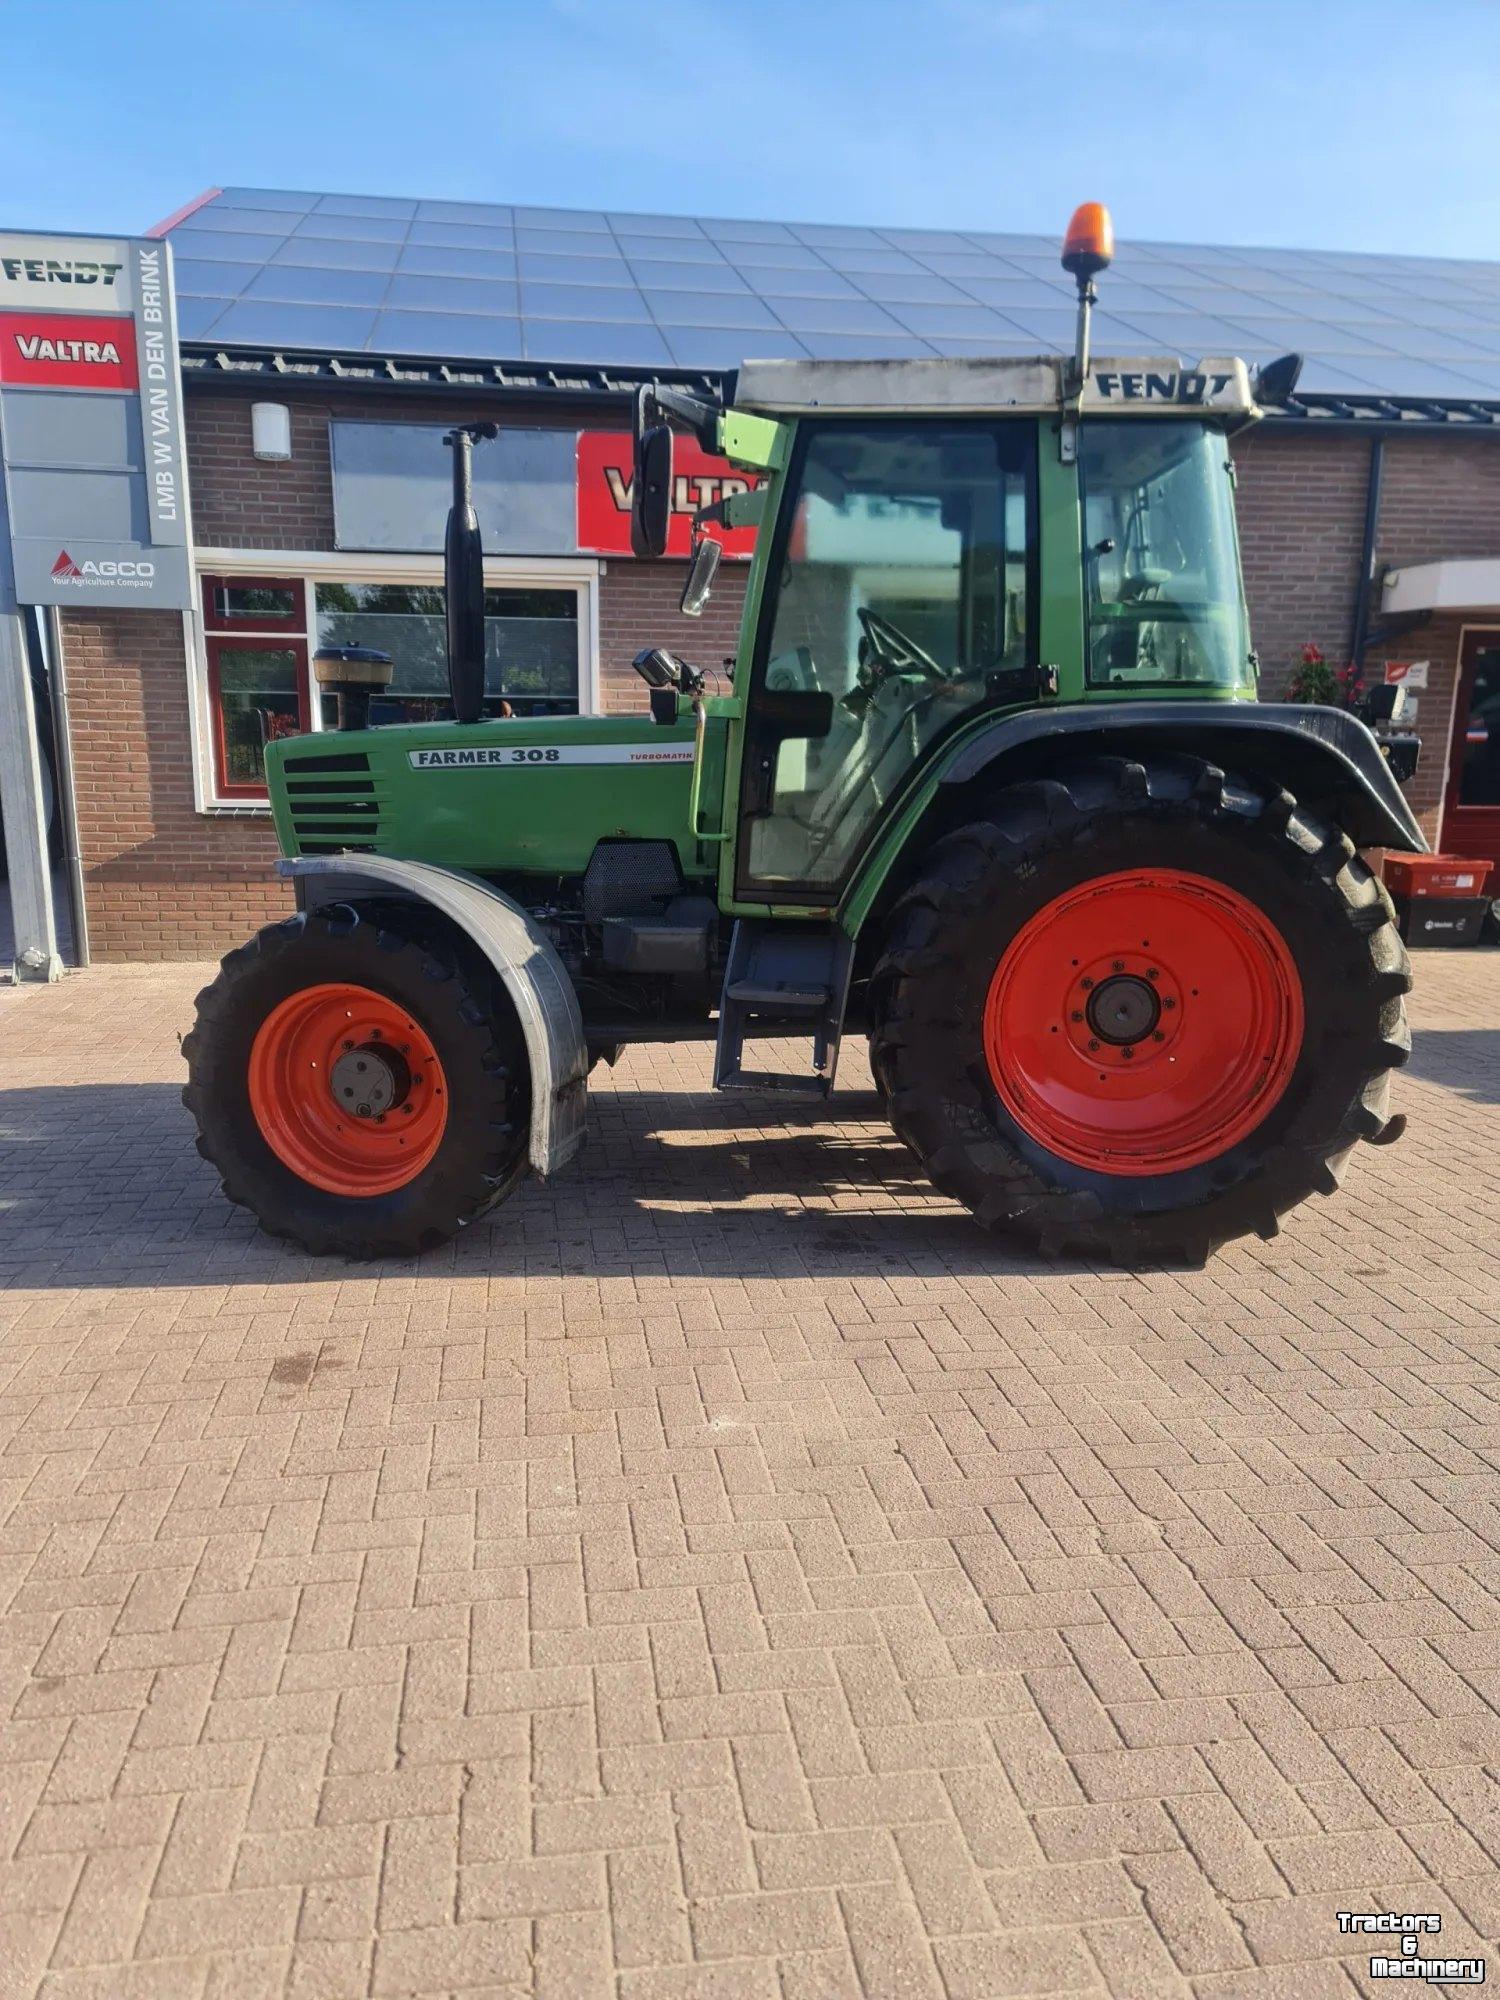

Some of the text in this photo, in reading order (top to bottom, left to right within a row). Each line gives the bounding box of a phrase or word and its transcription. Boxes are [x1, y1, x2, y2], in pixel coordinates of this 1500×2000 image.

[1, 258, 123, 285] FENDT
[14, 333, 122, 364] VALTRA
[139, 250, 176, 520] LMB W VAN DEN BRINK
[1095, 373, 1236, 401] FENDT
[81, 560, 155, 577] AGCO
[51, 576, 154, 589] Your Agriculture Company
[418, 749, 560, 765] FARMER 308
[629, 752, 693, 761] TURBOMATIK
